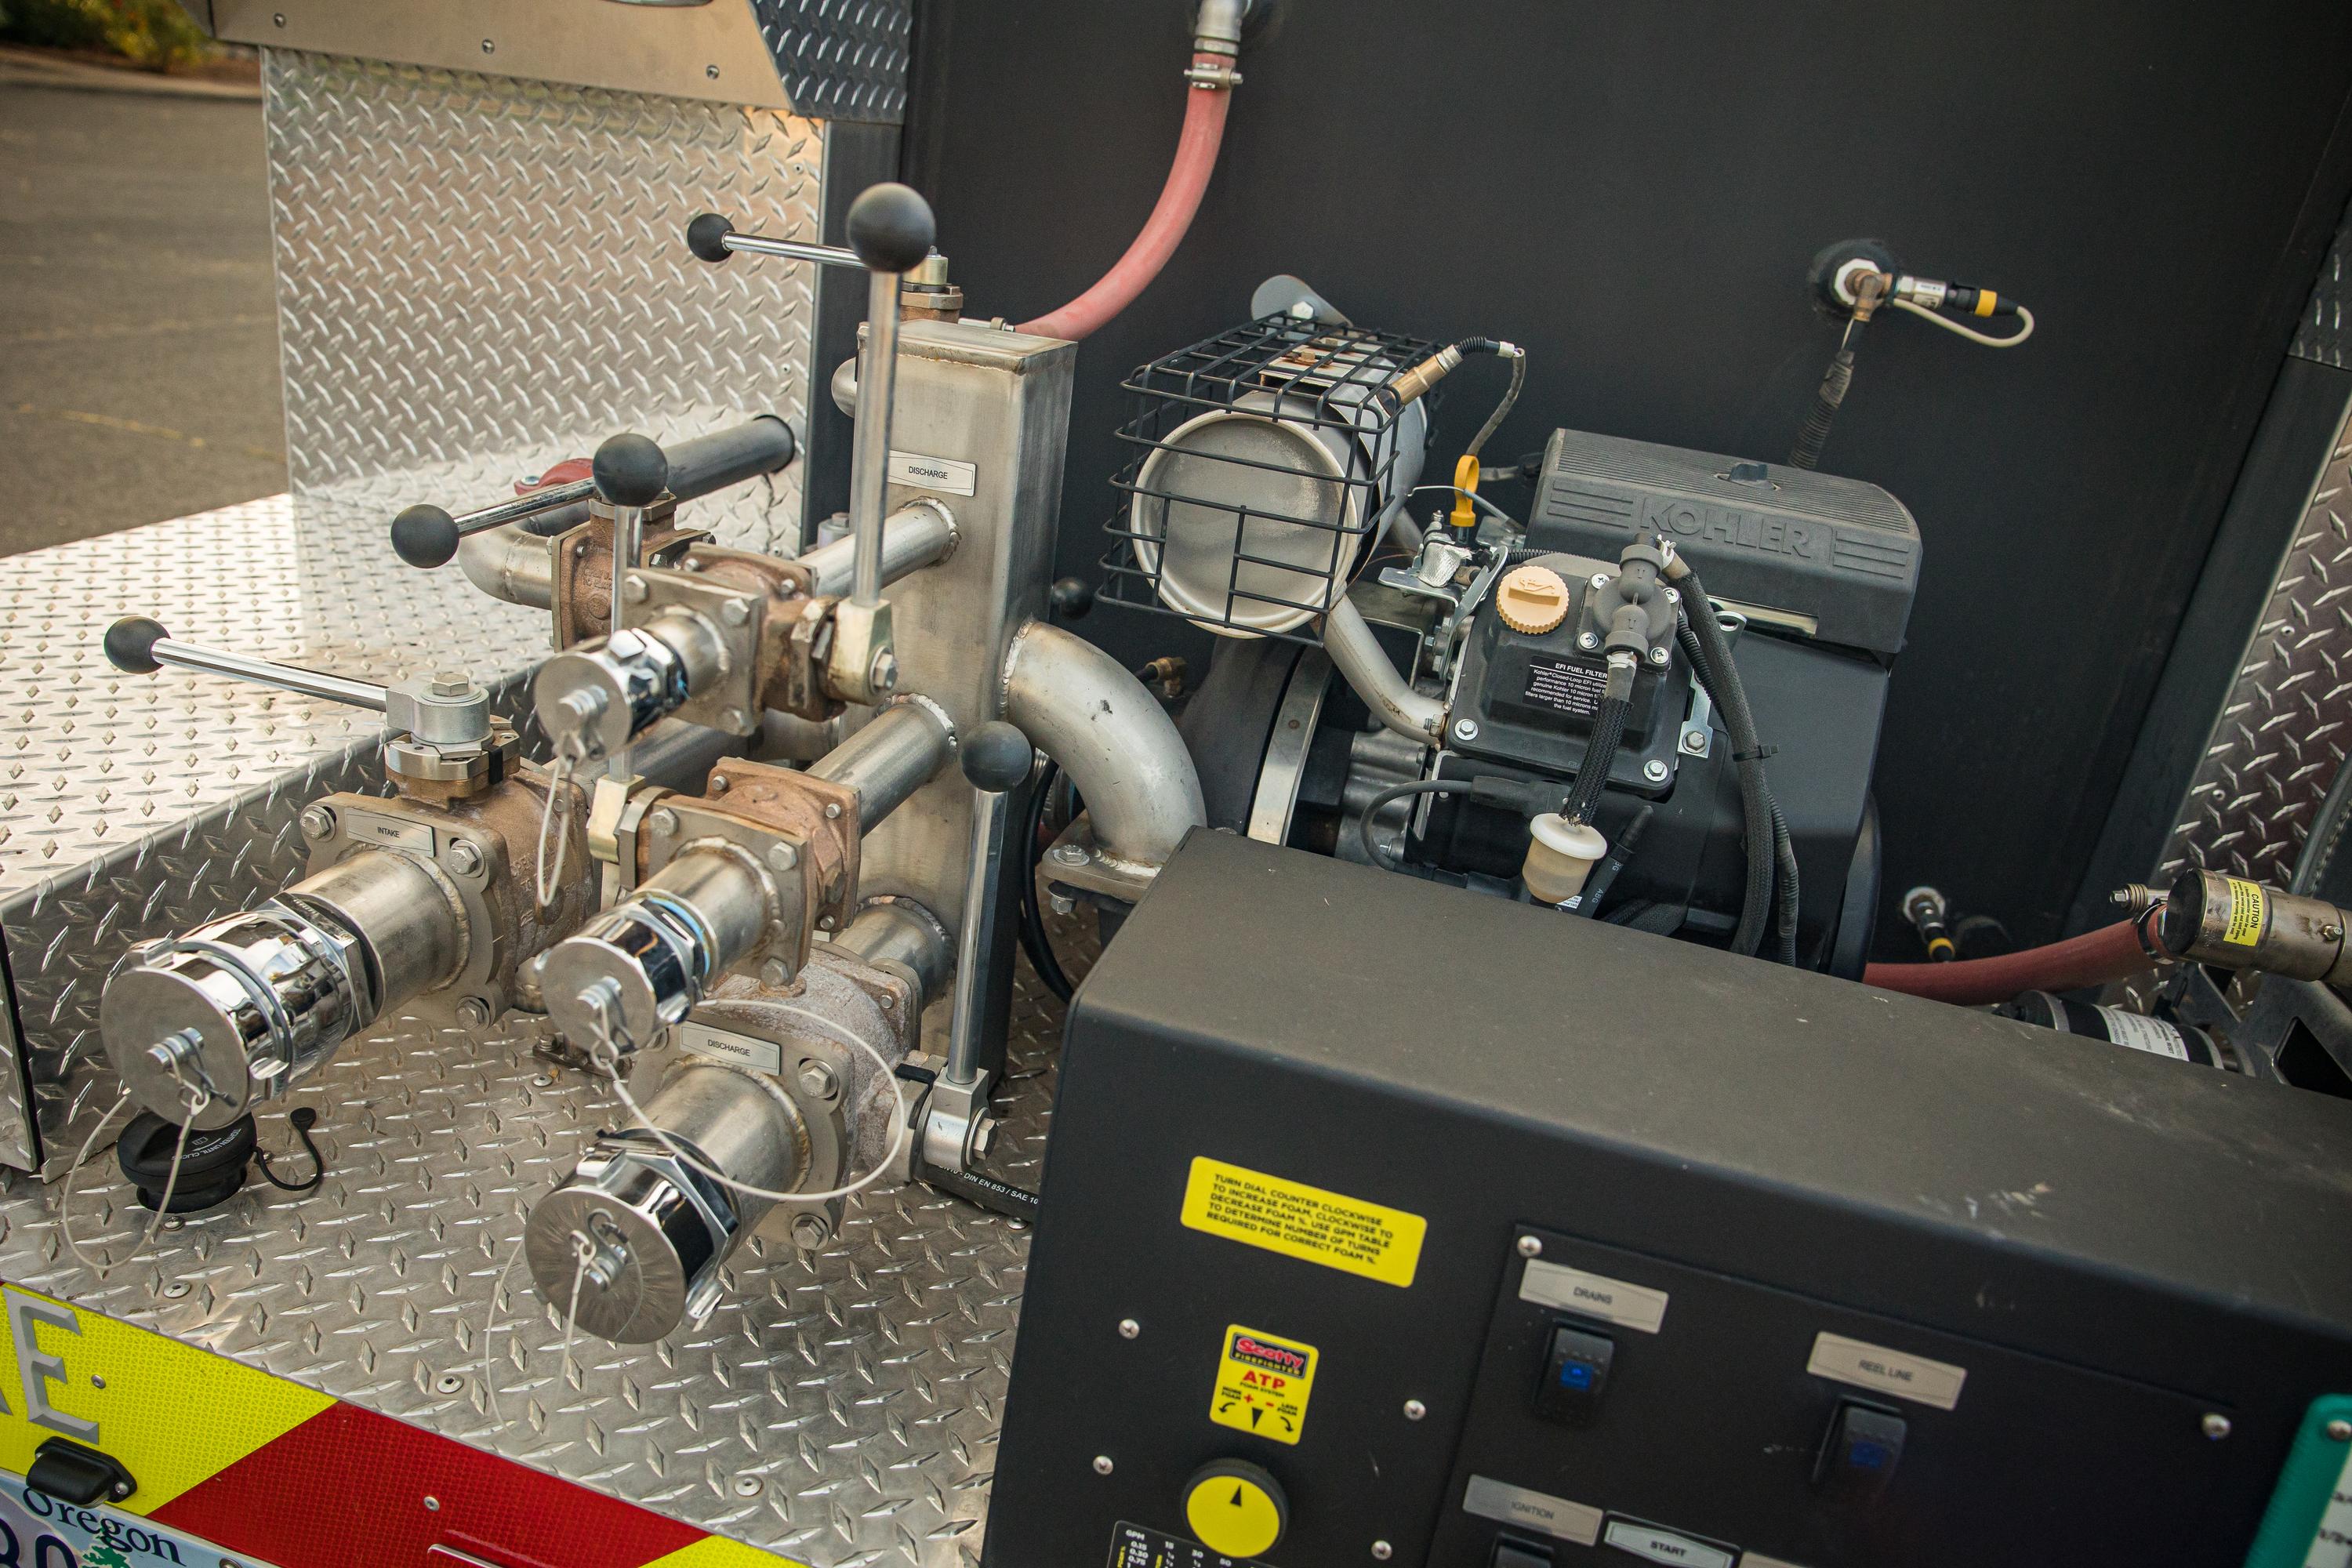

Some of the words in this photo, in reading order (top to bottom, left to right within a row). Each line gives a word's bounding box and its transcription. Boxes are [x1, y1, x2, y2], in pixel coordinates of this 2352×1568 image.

[908, 466, 948, 480] DISCHARGE
[1639, 496, 1811, 559] KOHLER
[1552, 673, 1583, 684] Closed-Loop
[1567, 666, 1584, 674] FUEL
[1585, 670, 1608, 679] FILTER
[1537, 677, 1567, 687] performance
[1531, 687, 1565, 698] recommended
[377, 826, 400, 838] INTAKE
[1611, 861, 1622, 872] BG
[1592, 888, 1604, 903] ABG
[2249, 894, 2259, 929] CAUTION
[707, 1039, 751, 1057] DISCHARGE
[200, 1145, 222, 1154] UNTIL
[964, 1172, 978, 1183] DIN
[978, 1178, 991, 1188] EN
[991, 1183, 1006, 1193] 853
[1011, 1189, 1029, 1202] SAE
[1214, 1174, 1242, 1188] TURN
[1244, 1183, 1268, 1195] DIAL
[1269, 1189, 1319, 1209] COUNTER
[1322, 1203, 1383, 1225] CLOCKWISE
[1210, 1193, 1263, 1214] DECREASE
[1265, 1208, 1296, 1222] FOAM
[1311, 1221, 1330, 1232] USE
[1333, 1227, 1356, 1239] GPM
[1358, 1234, 1390, 1248] TABLE
[1213, 1184, 1226, 1193] TO
[1229, 1188, 1279, 1207] INCREASE
[1316, 1213, 1377, 1235] CLOCKWISE
[1380, 1230, 1393, 1240] TO
[1206, 1211, 1258, 1232] REQUIRED
[1260, 1226, 1281, 1237] FOR
[1283, 1232, 1331, 1251] CORRECT
[1334, 1247, 1363, 1261] FOAM
[1209, 1203, 1222, 1212] TO
[1225, 1207, 1281, 1229] DETERMINE
[1284, 1223, 1327, 1241] NUMBER
[1330, 1236, 1344, 1246] OF
[1347, 1241, 1381, 1256] TURNS
[1573, 1287, 1613, 1305] DRAINS
[1236, 1337, 1305, 1368] Scotty
[1235, 1352, 1301, 1375] FIREFIGHTER
[1243, 1370, 1287, 1389] ATP
[1888, 1367, 1913, 1381] LINE
[1511, 1501, 1555, 1519] IGNITION
[23, 1488, 187, 1567] Oregon
[1125, 1529, 1145, 1541] GPM
[1164, 1541, 1175, 1550] 15
[1192, 1549, 1204, 1559] 30
[1219, 1558, 1232, 1567] 50
[1129, 1548, 1149, 1559] 0.30
[1131, 1541, 1148, 1551] 0.15
[1650, 1541, 1688, 1558] START
[1127, 1555, 1147, 1566] 0.75
